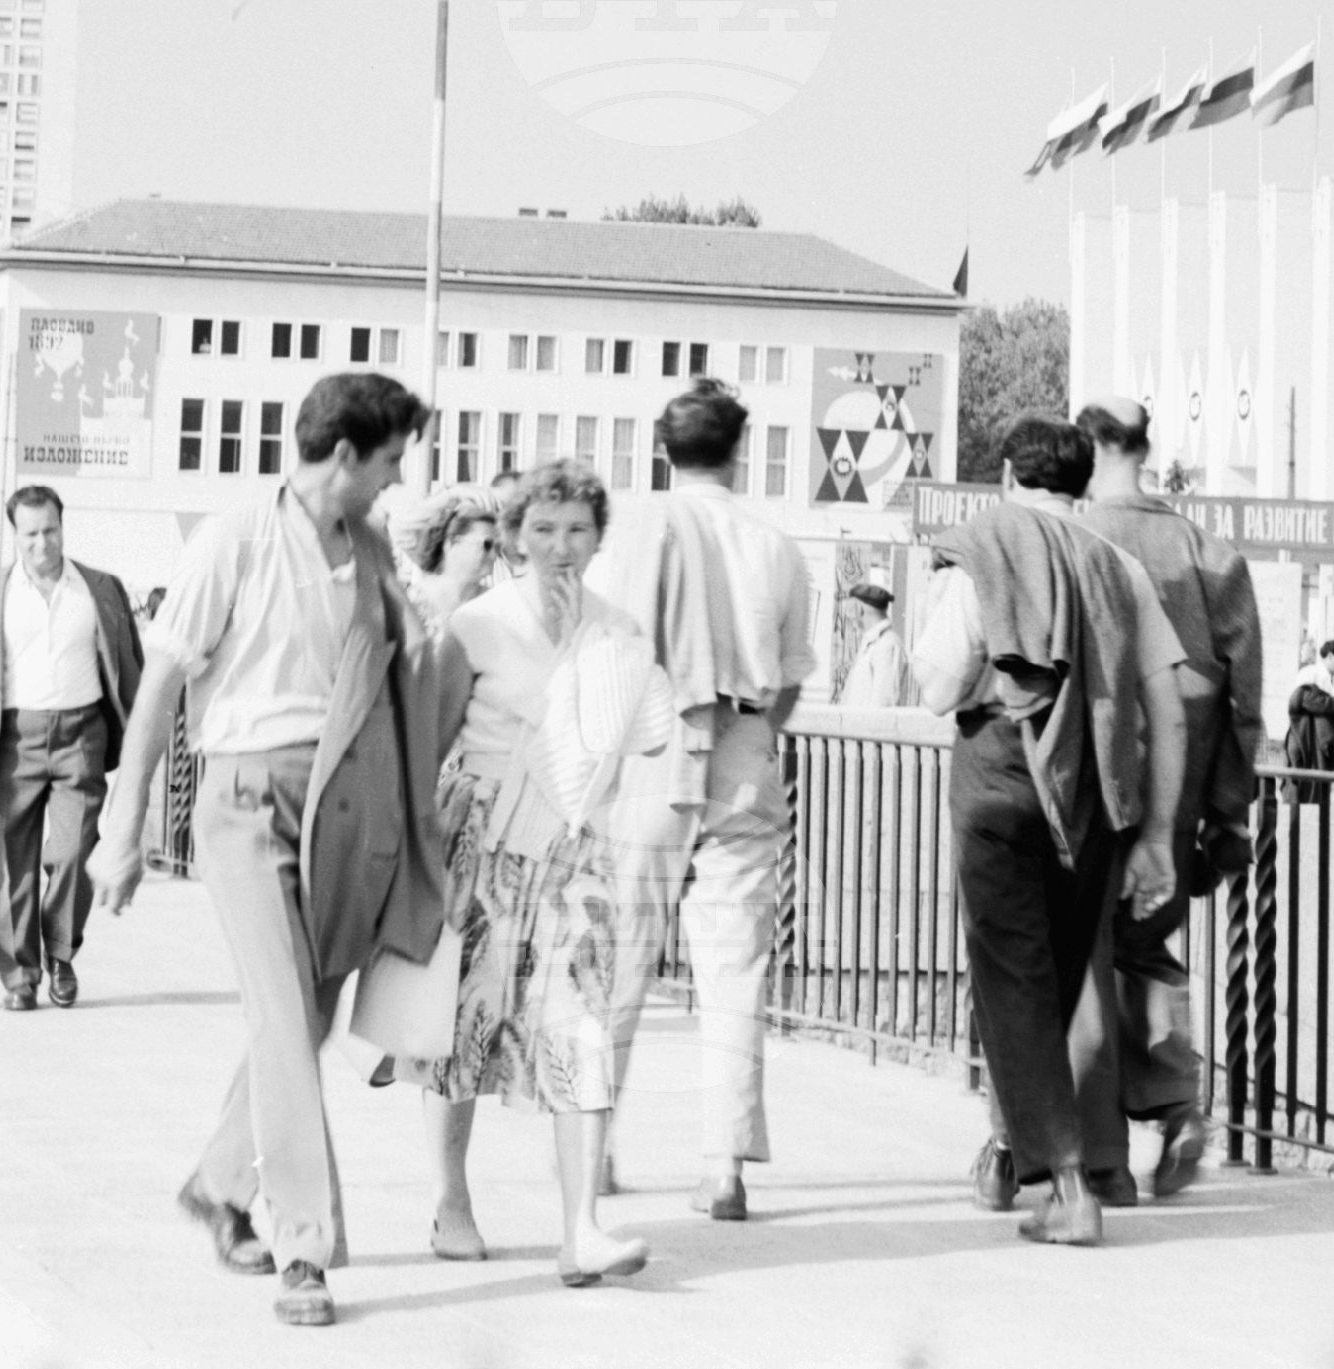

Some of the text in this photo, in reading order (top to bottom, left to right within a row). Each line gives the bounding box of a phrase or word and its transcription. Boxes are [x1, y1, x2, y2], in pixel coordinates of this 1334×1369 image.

[30, 316, 95, 334] ПЛОВДИВ
[23, 446, 129, 466] ИЗЛОЖЕНИЕ
[1213, 503, 1235, 540] ЗА
[1243, 504, 1328, 545] РАЗВИТИЕ
